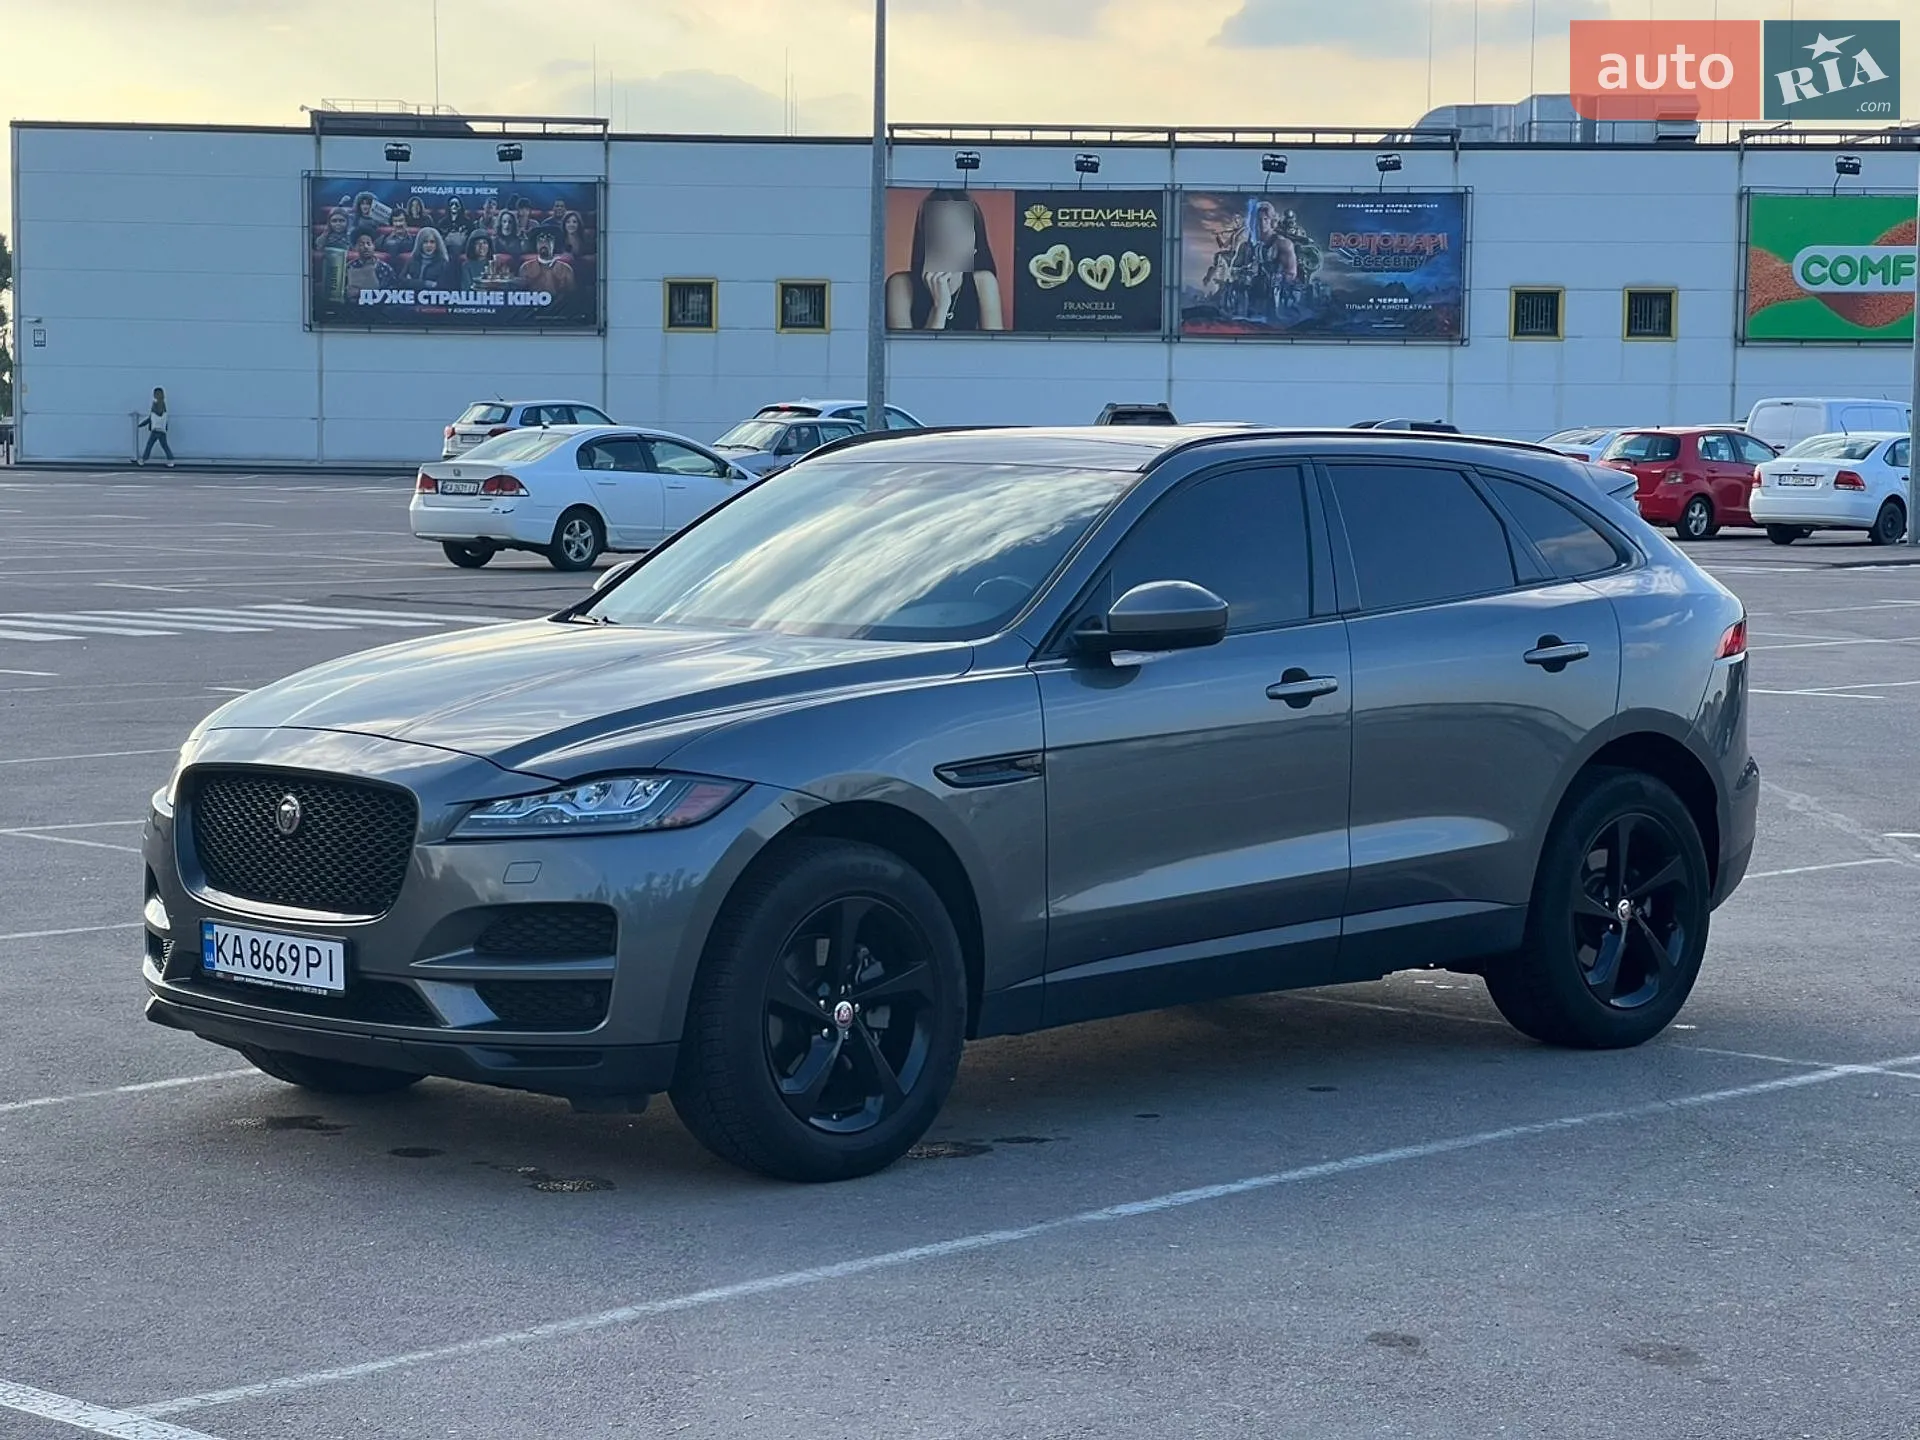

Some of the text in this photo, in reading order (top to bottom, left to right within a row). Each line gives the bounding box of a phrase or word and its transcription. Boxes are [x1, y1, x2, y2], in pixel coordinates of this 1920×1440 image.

[410, 186, 453, 195] КОМЕДІЯ
[1057, 208, 1157, 220] СТОЛИЧНА
[1329, 232, 1448, 255] ВОЛОДАРІ
[358, 289, 552, 306] ДУЖЕ СТРАШНЕ КІНО
